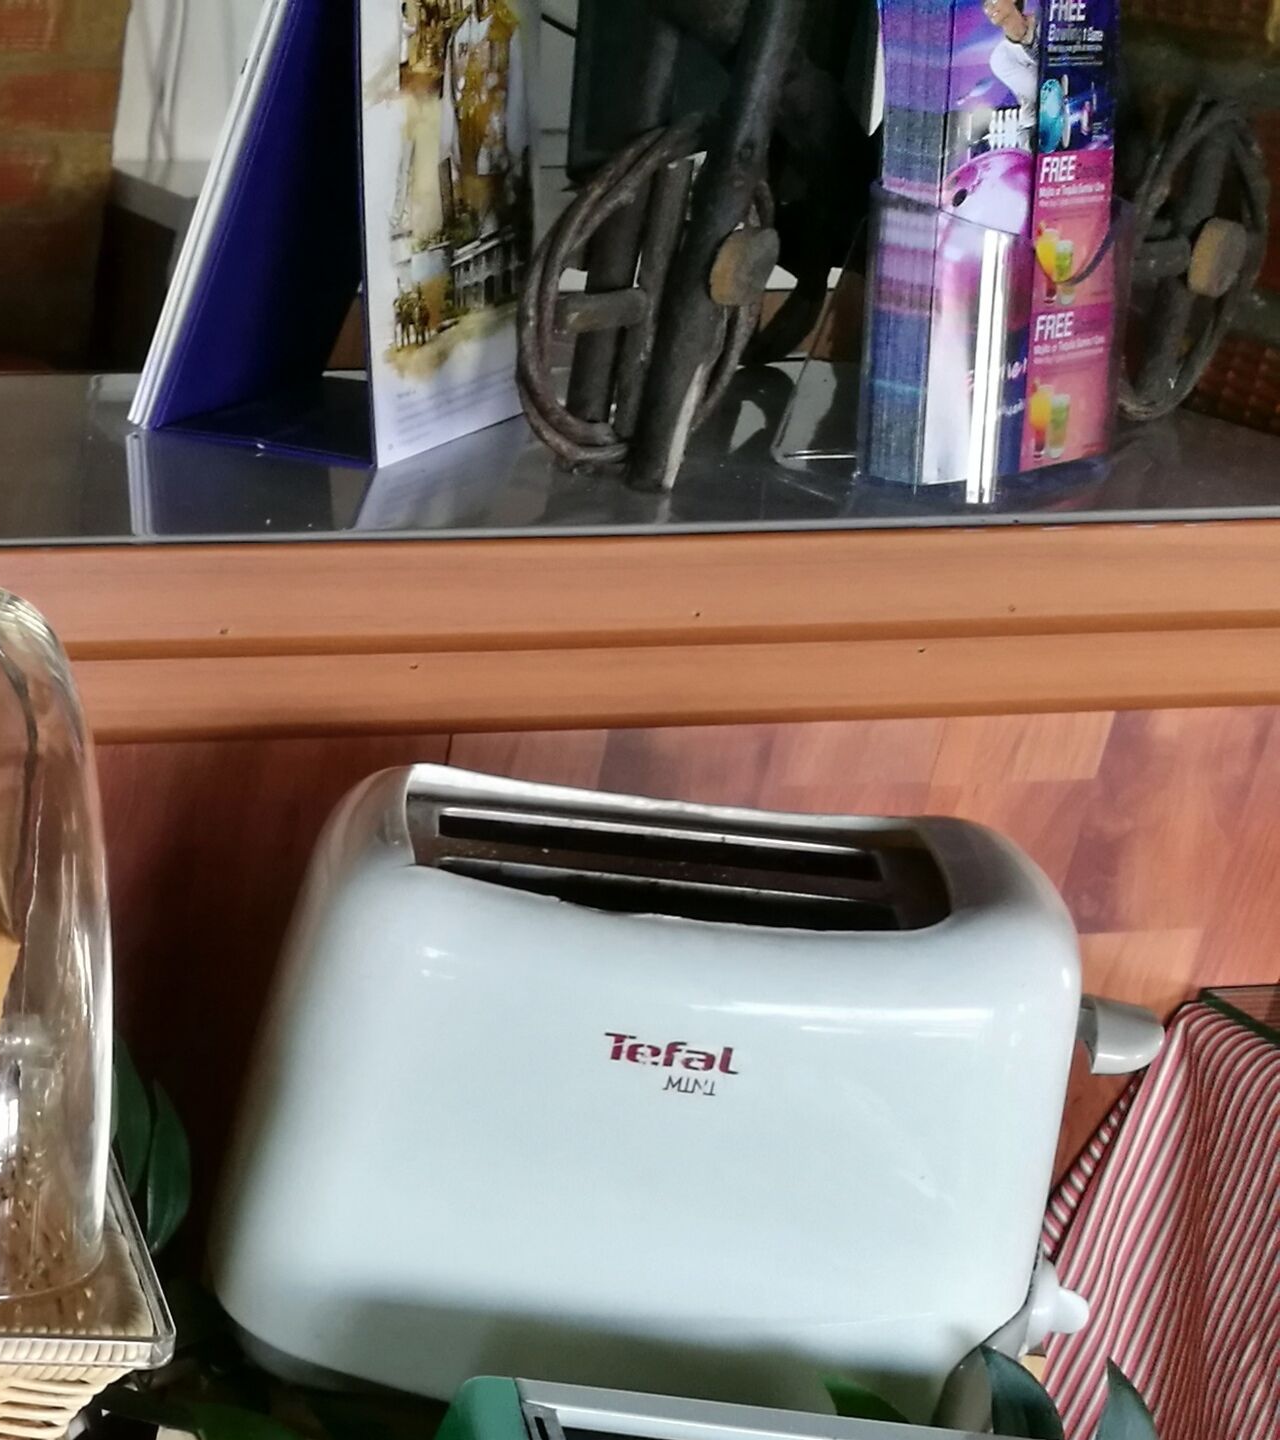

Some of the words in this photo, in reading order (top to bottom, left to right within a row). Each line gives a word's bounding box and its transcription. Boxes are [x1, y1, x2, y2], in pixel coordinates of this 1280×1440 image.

[1040, 155, 1077, 184] FREE
[1034, 311, 1074, 342] FREE
[604, 1032, 739, 1075] Tefal
[662, 1074, 716, 1096] MINI
